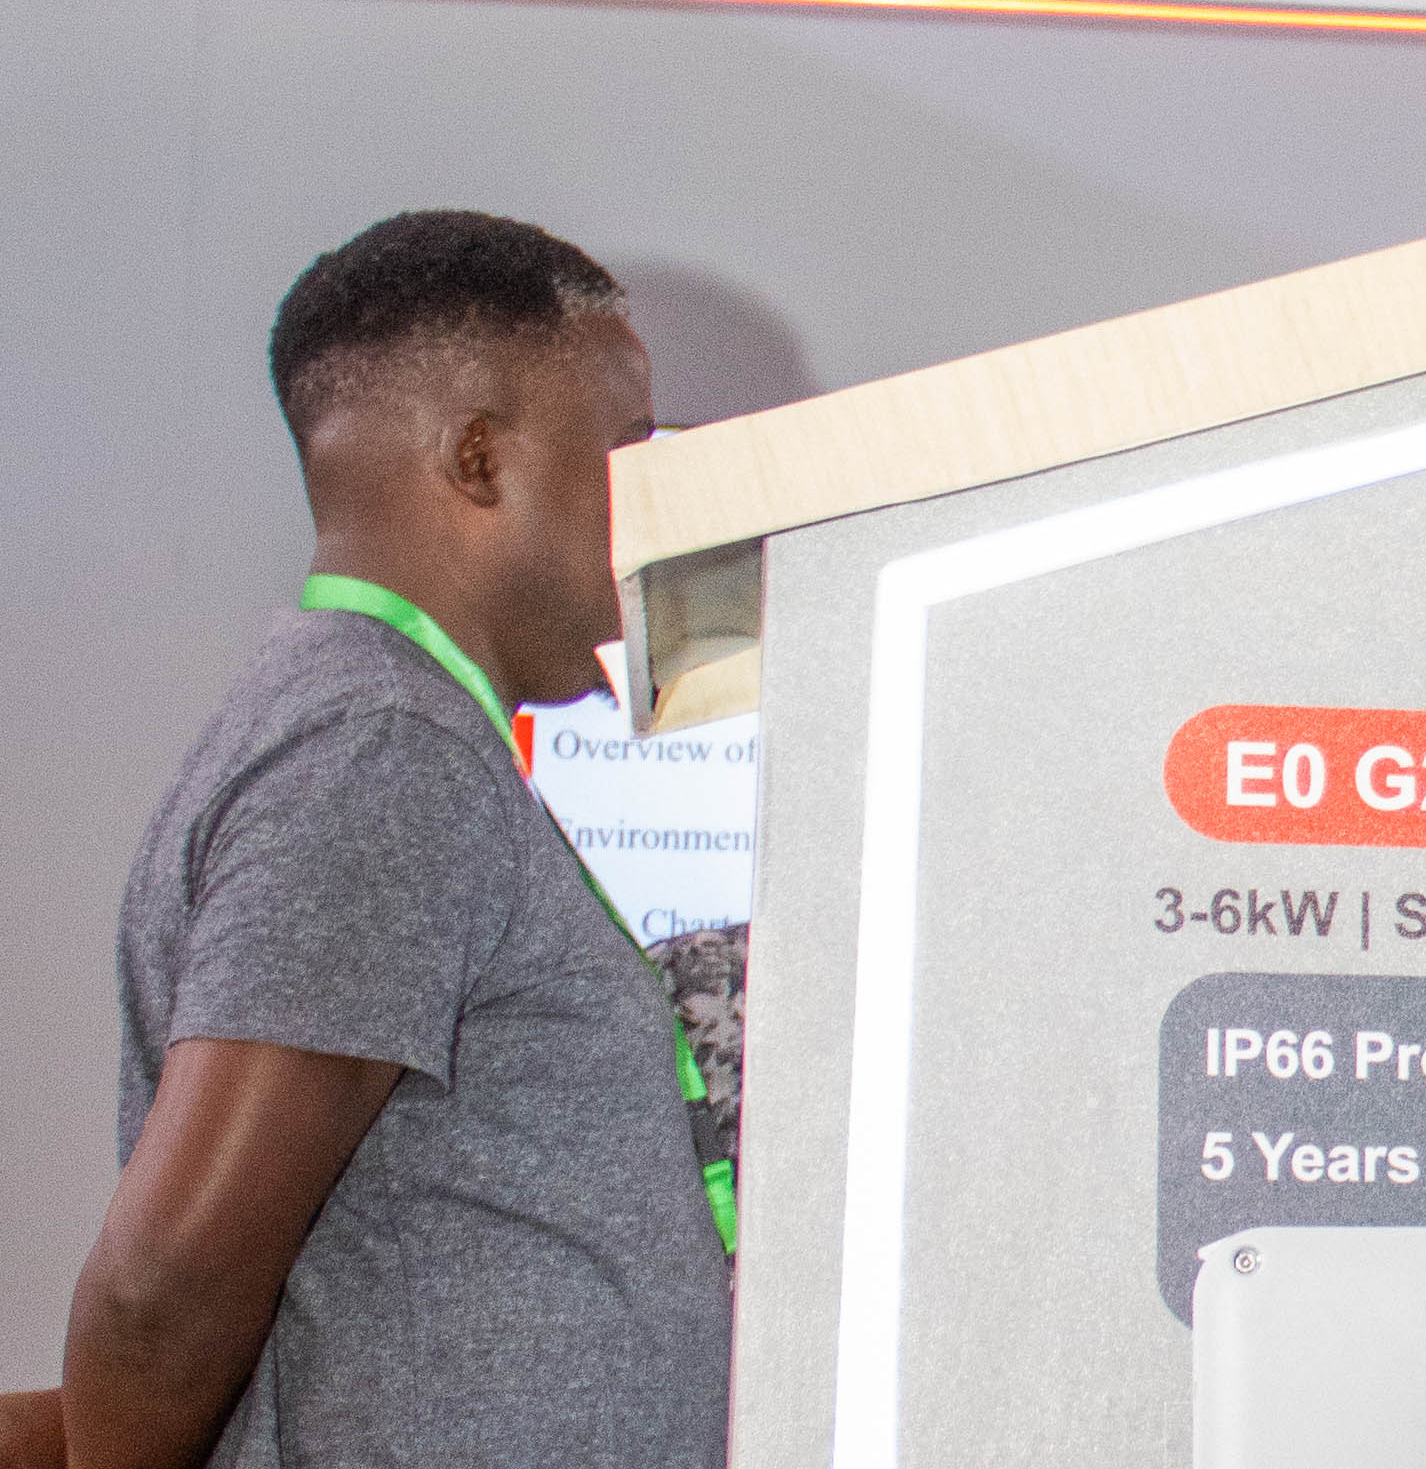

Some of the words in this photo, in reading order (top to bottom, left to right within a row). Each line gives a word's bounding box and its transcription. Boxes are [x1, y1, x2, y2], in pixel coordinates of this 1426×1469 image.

[553, 730, 712, 762] Overview
[1153, 886, 1340, 937] 3-6kW
[1204, 1028, 1334, 1081] IP66
[1200, 1131, 1235, 1182] 5
[1252, 1131, 1421, 1184] Years
